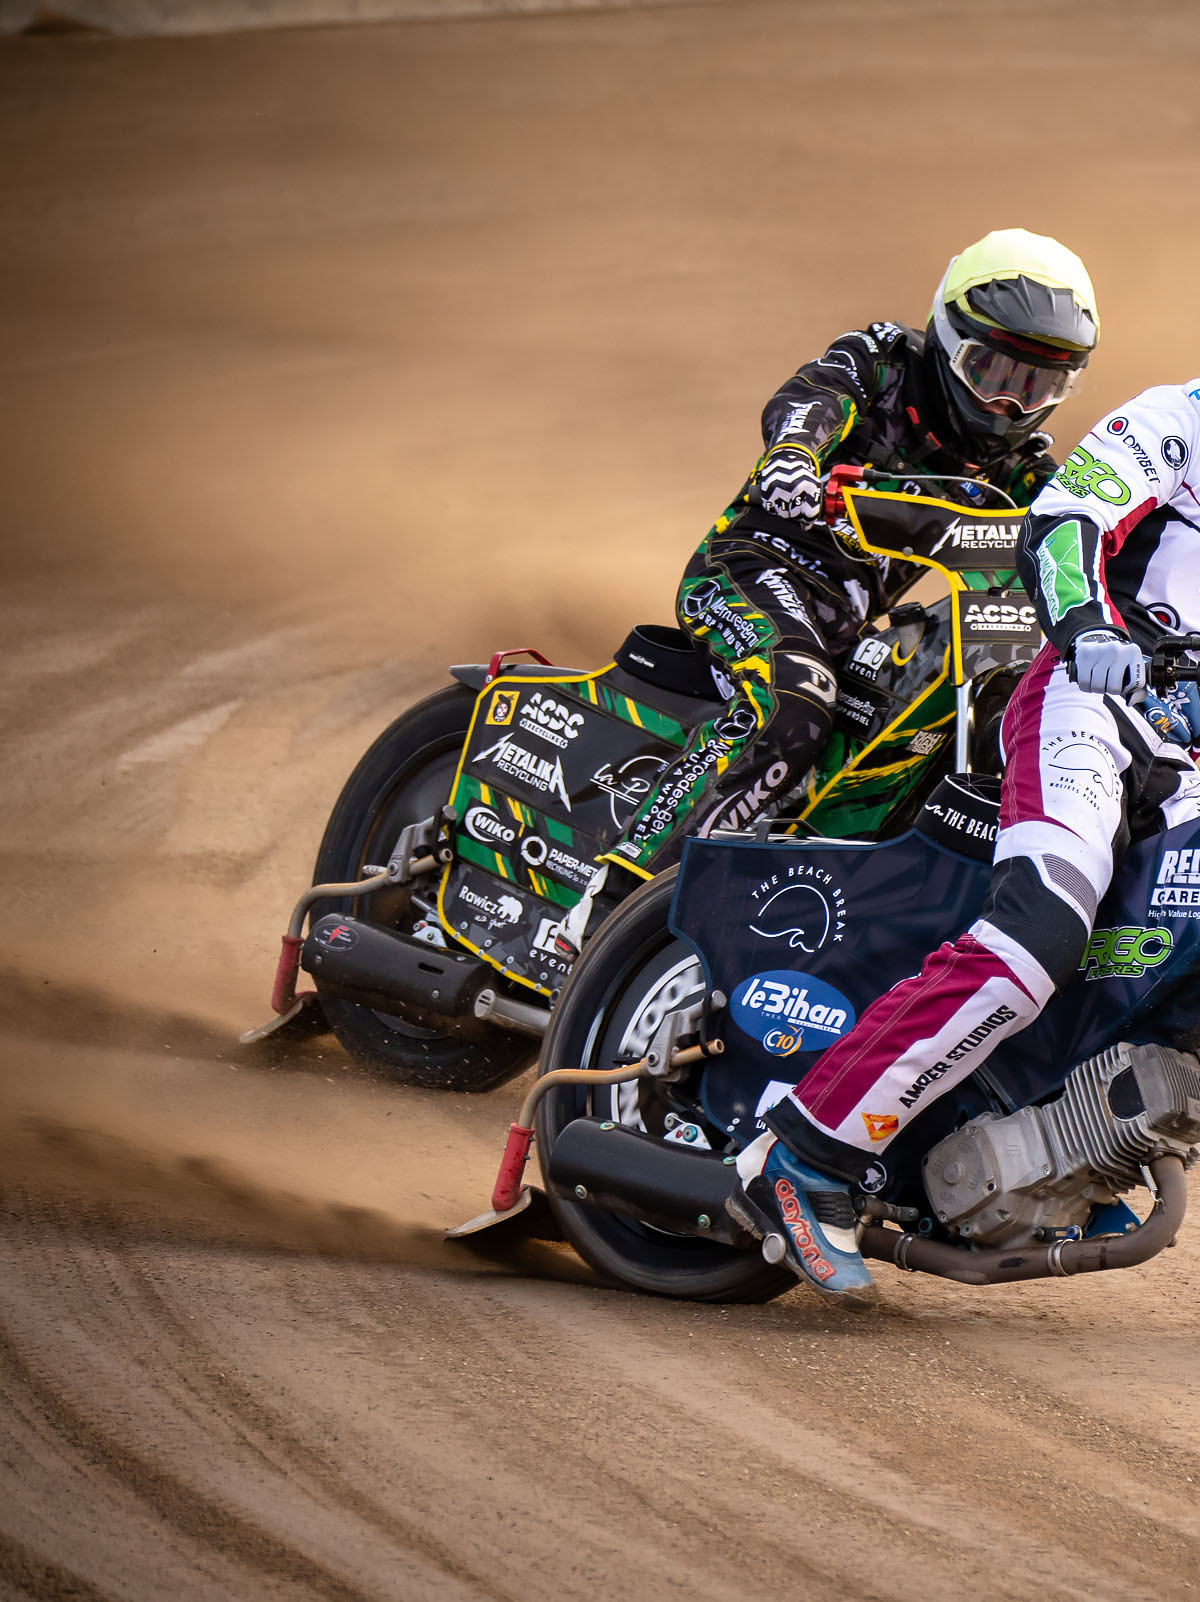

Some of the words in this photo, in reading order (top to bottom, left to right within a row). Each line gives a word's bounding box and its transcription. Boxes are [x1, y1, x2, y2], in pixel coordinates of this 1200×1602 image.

[1123, 434, 1161, 484] OPTIBET
[964, 604, 1037, 625] ACDC
[849, 662, 877, 681] event
[520, 692, 584, 739] ACDC
[526, 721, 560, 743] RECYCLING
[1042, 736, 1063, 751] THE
[1071, 731, 1109, 754] BEACH
[471, 732, 572, 813] METALIKA
[497, 760, 549, 792] RECYCLING
[475, 813, 515, 842] WIKO
[943, 808, 967, 830] THE
[459, 885, 499, 915] Rawicz
[752, 875, 778, 900] THE
[788, 865, 833, 886] BEACH
[832, 888, 847, 943] BREAK
[1148, 909, 1166, 920] High
[1168, 910, 1187, 918] Value
[1088, 965, 1143, 979] FRERES
[766, 1031, 794, 1050] C10
[898, 1061, 954, 1109] AMBER
[945, 1004, 1019, 1061] STUDIOS
[775, 1178, 836, 1282] daytona
